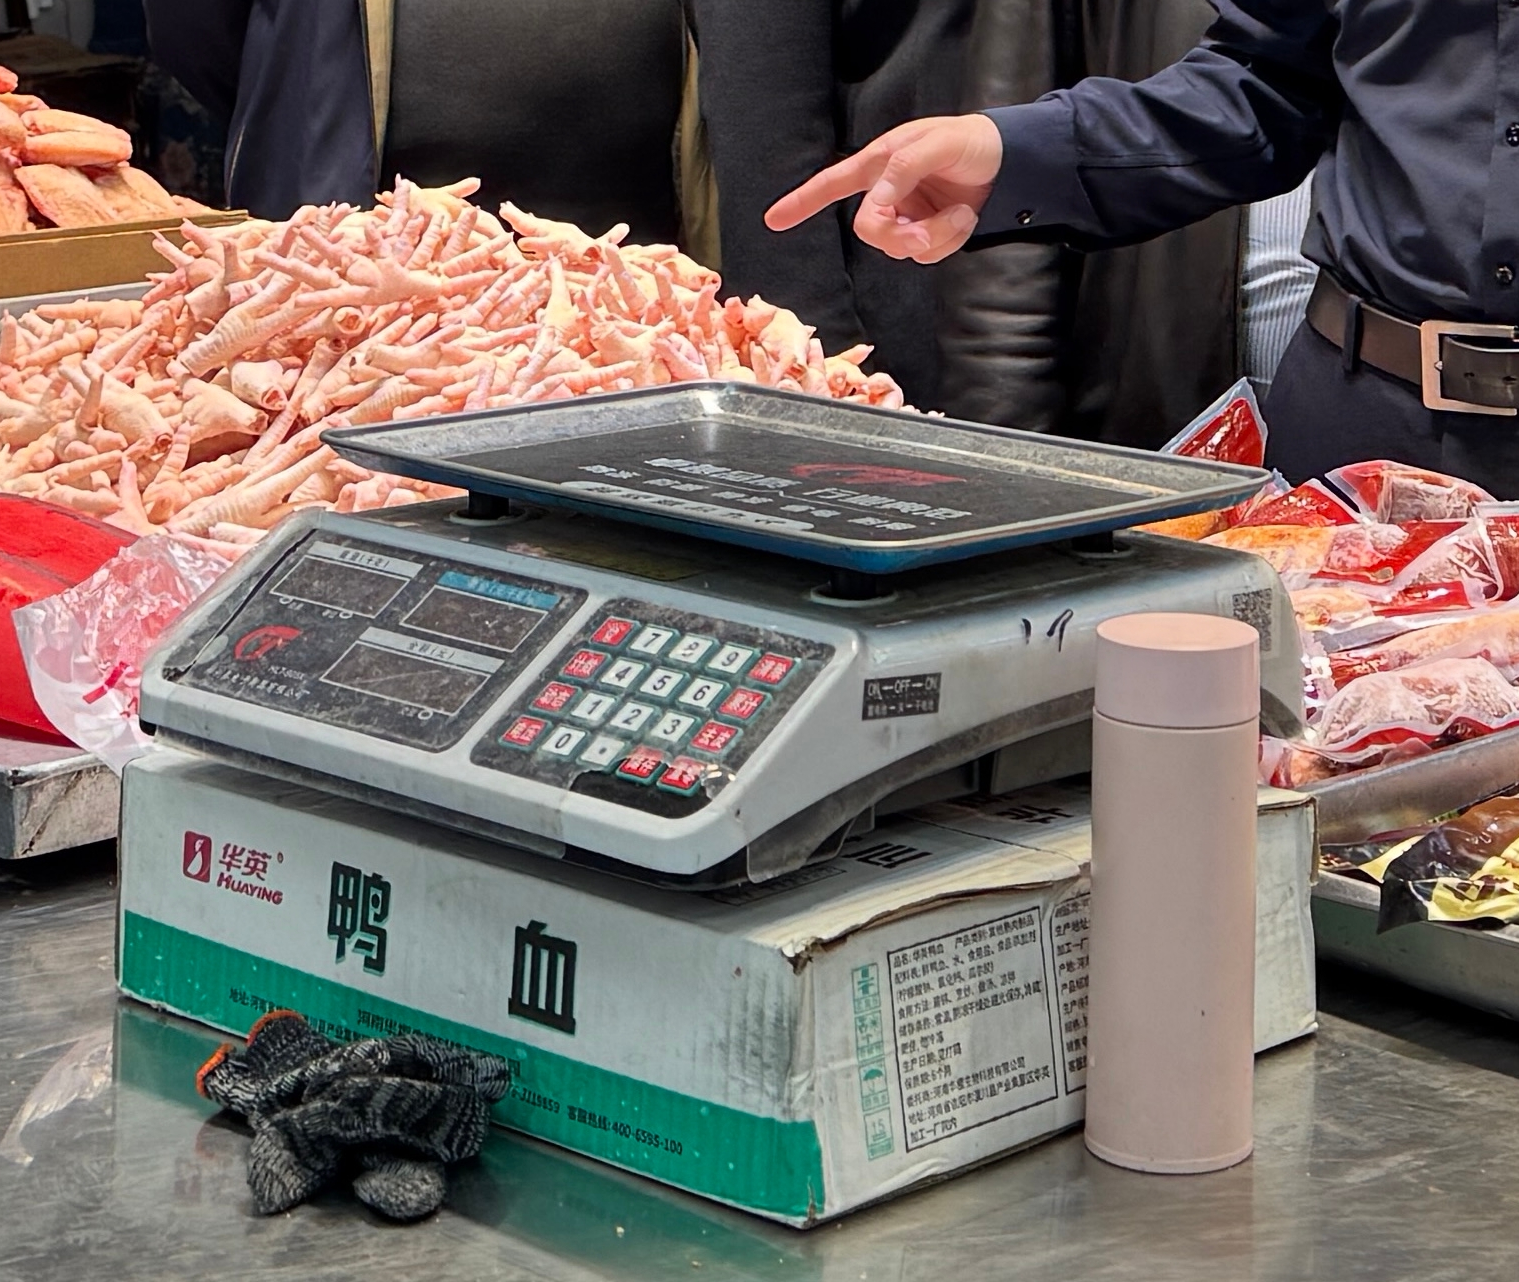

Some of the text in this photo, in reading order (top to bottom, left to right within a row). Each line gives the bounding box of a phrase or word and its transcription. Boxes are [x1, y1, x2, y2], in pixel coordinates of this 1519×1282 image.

[642, 632, 662, 649] 7
[681, 641, 700, 658] 8
[721, 651, 740, 667] 9
[615, 666, 633, 682] 4
[652, 675, 672, 691] 5
[867, 676, 939, 696] ON OFF ON
[692, 684, 711, 701] 6
[587, 699, 603, 716] 1
[623, 708, 642, 726] 2
[663, 718, 682, 735] 3
[554, 733, 572, 749] 0
[218, 843, 273, 882] 华英
[216, 872, 284, 906] HUAYING
